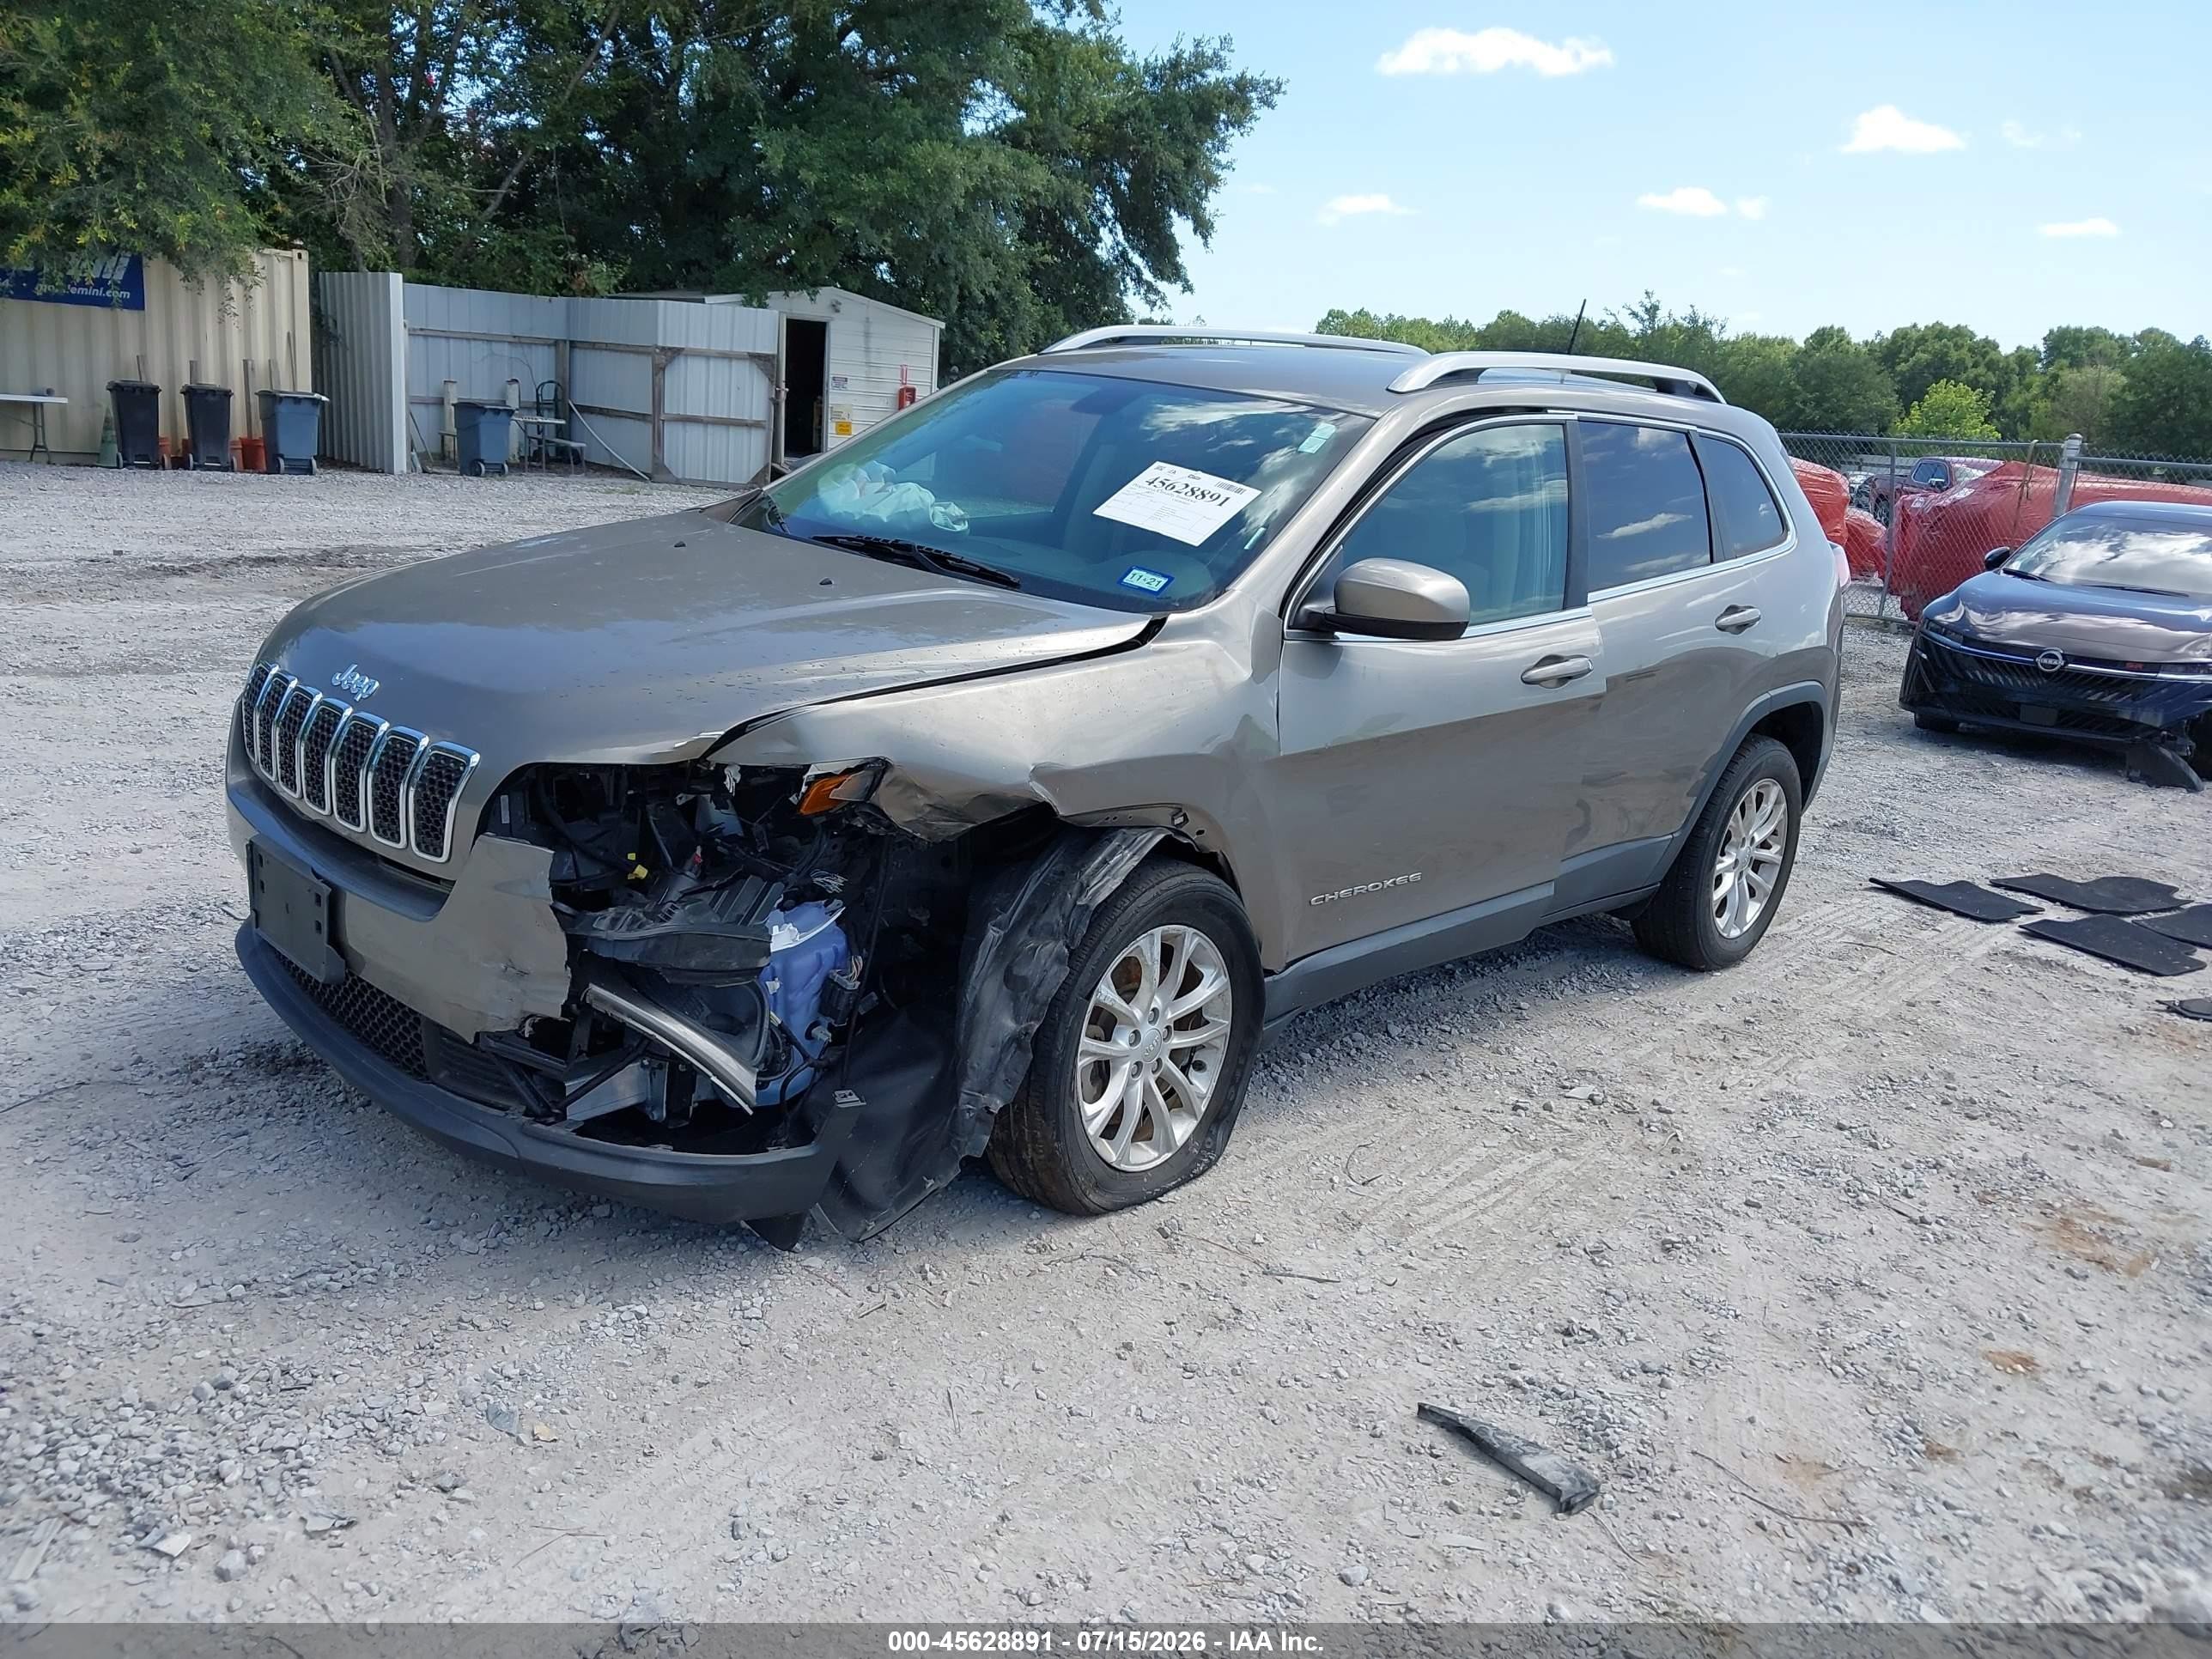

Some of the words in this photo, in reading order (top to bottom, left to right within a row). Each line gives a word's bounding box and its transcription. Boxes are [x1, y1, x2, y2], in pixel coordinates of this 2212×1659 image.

[1146, 476, 1231, 507] 45628891
[331, 664, 380, 702] Jeep
[1310, 872, 1423, 907] CHEROKEE
